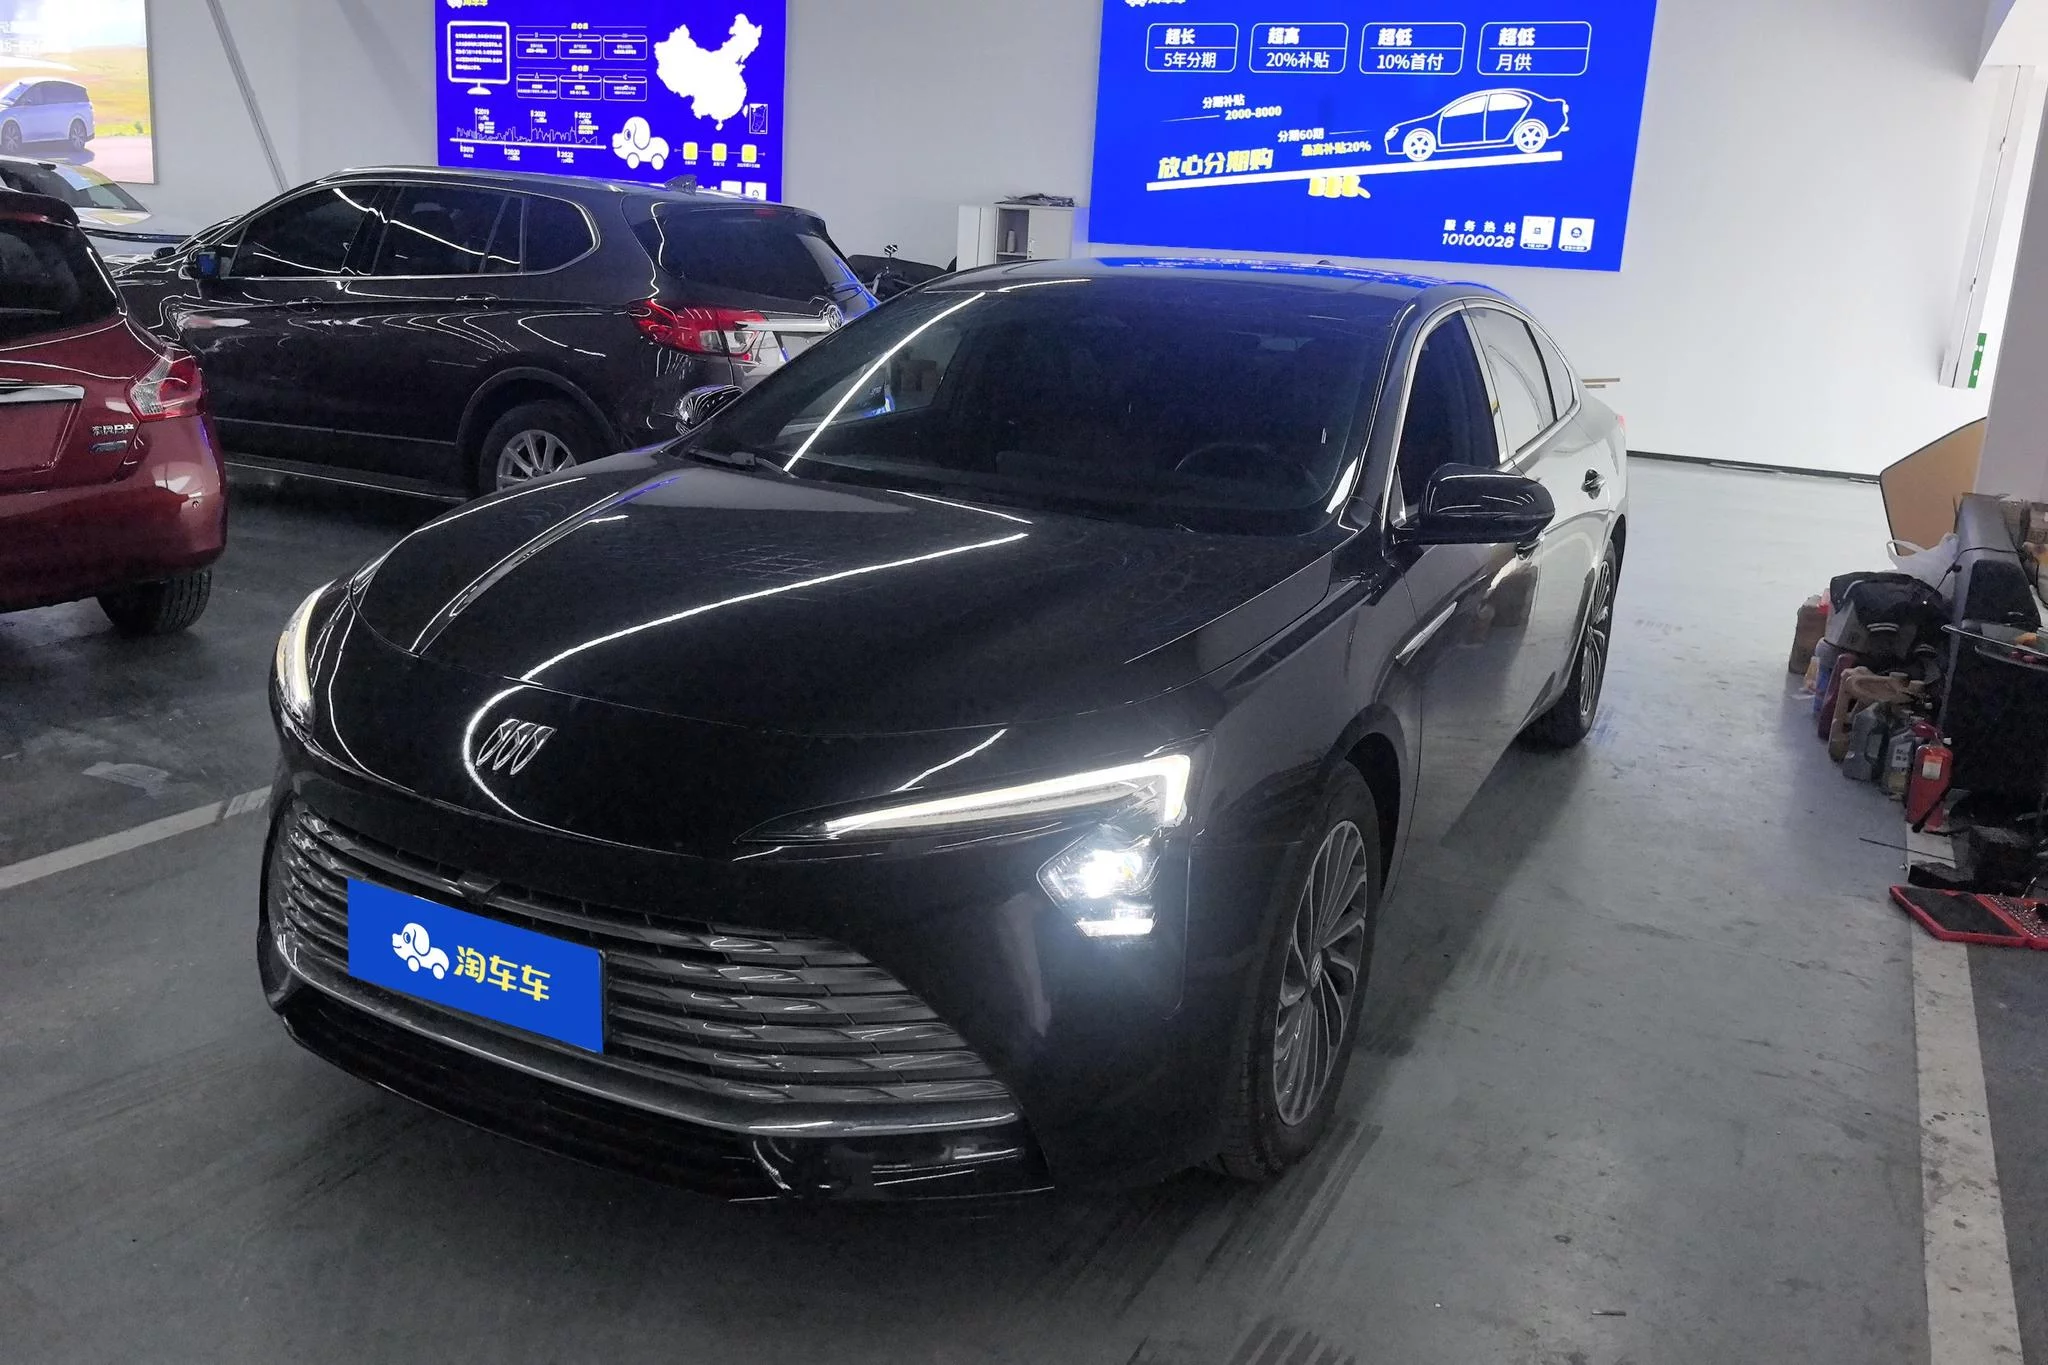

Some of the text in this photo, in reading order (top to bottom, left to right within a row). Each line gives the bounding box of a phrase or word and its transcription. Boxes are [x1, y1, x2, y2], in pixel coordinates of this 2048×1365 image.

[1165, 27, 1196, 45] 超长
[1267, 26, 1301, 45] 超高
[1378, 27, 1413, 46] 超低
[1498, 27, 1536, 46] 超低
[1163, 51, 1217, 69] 5年分期
[1266, 51, 1330, 69] 20%补贴
[1376, 53, 1444, 71] 10%首付
[1495, 53, 1532, 71] 月供
[1202, 93, 1245, 109] 分期补贴
[1224, 106, 1282, 121] 2000-8000
[1277, 128, 1325, 143] 分期60期
[1301, 141, 1372, 157] 最高补贴20%
[1157, 148, 1274, 180] 放心分期购
[1443, 218, 1516, 234] 服务热线
[1441, 232, 1515, 249] 10100028
